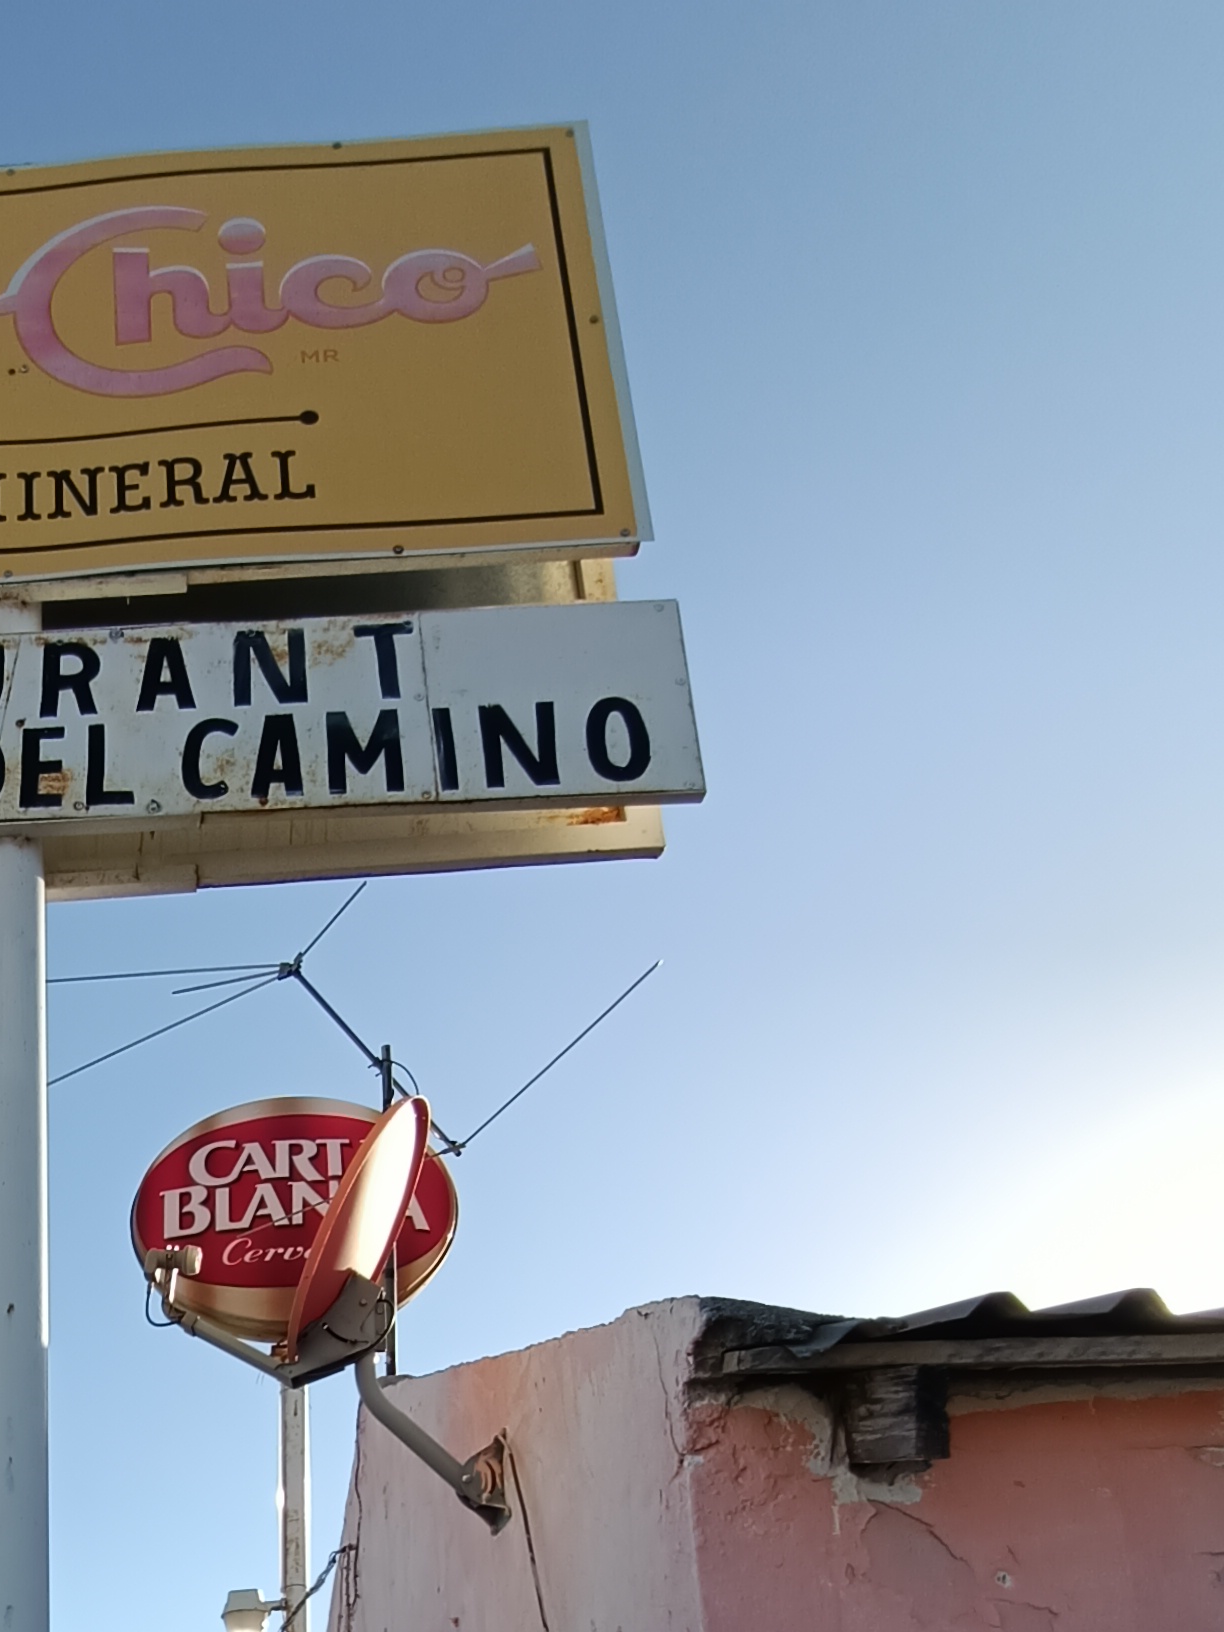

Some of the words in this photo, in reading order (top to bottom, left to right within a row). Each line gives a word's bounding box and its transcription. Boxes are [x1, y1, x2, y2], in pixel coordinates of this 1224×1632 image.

[300, 348, 339, 364] MR
[181, 697, 652, 802] CAMINO
[188, 1138, 366, 1187] CART
[159, 1179, 431, 1240] BLANA
[221, 1237, 312, 1266] Cerv
